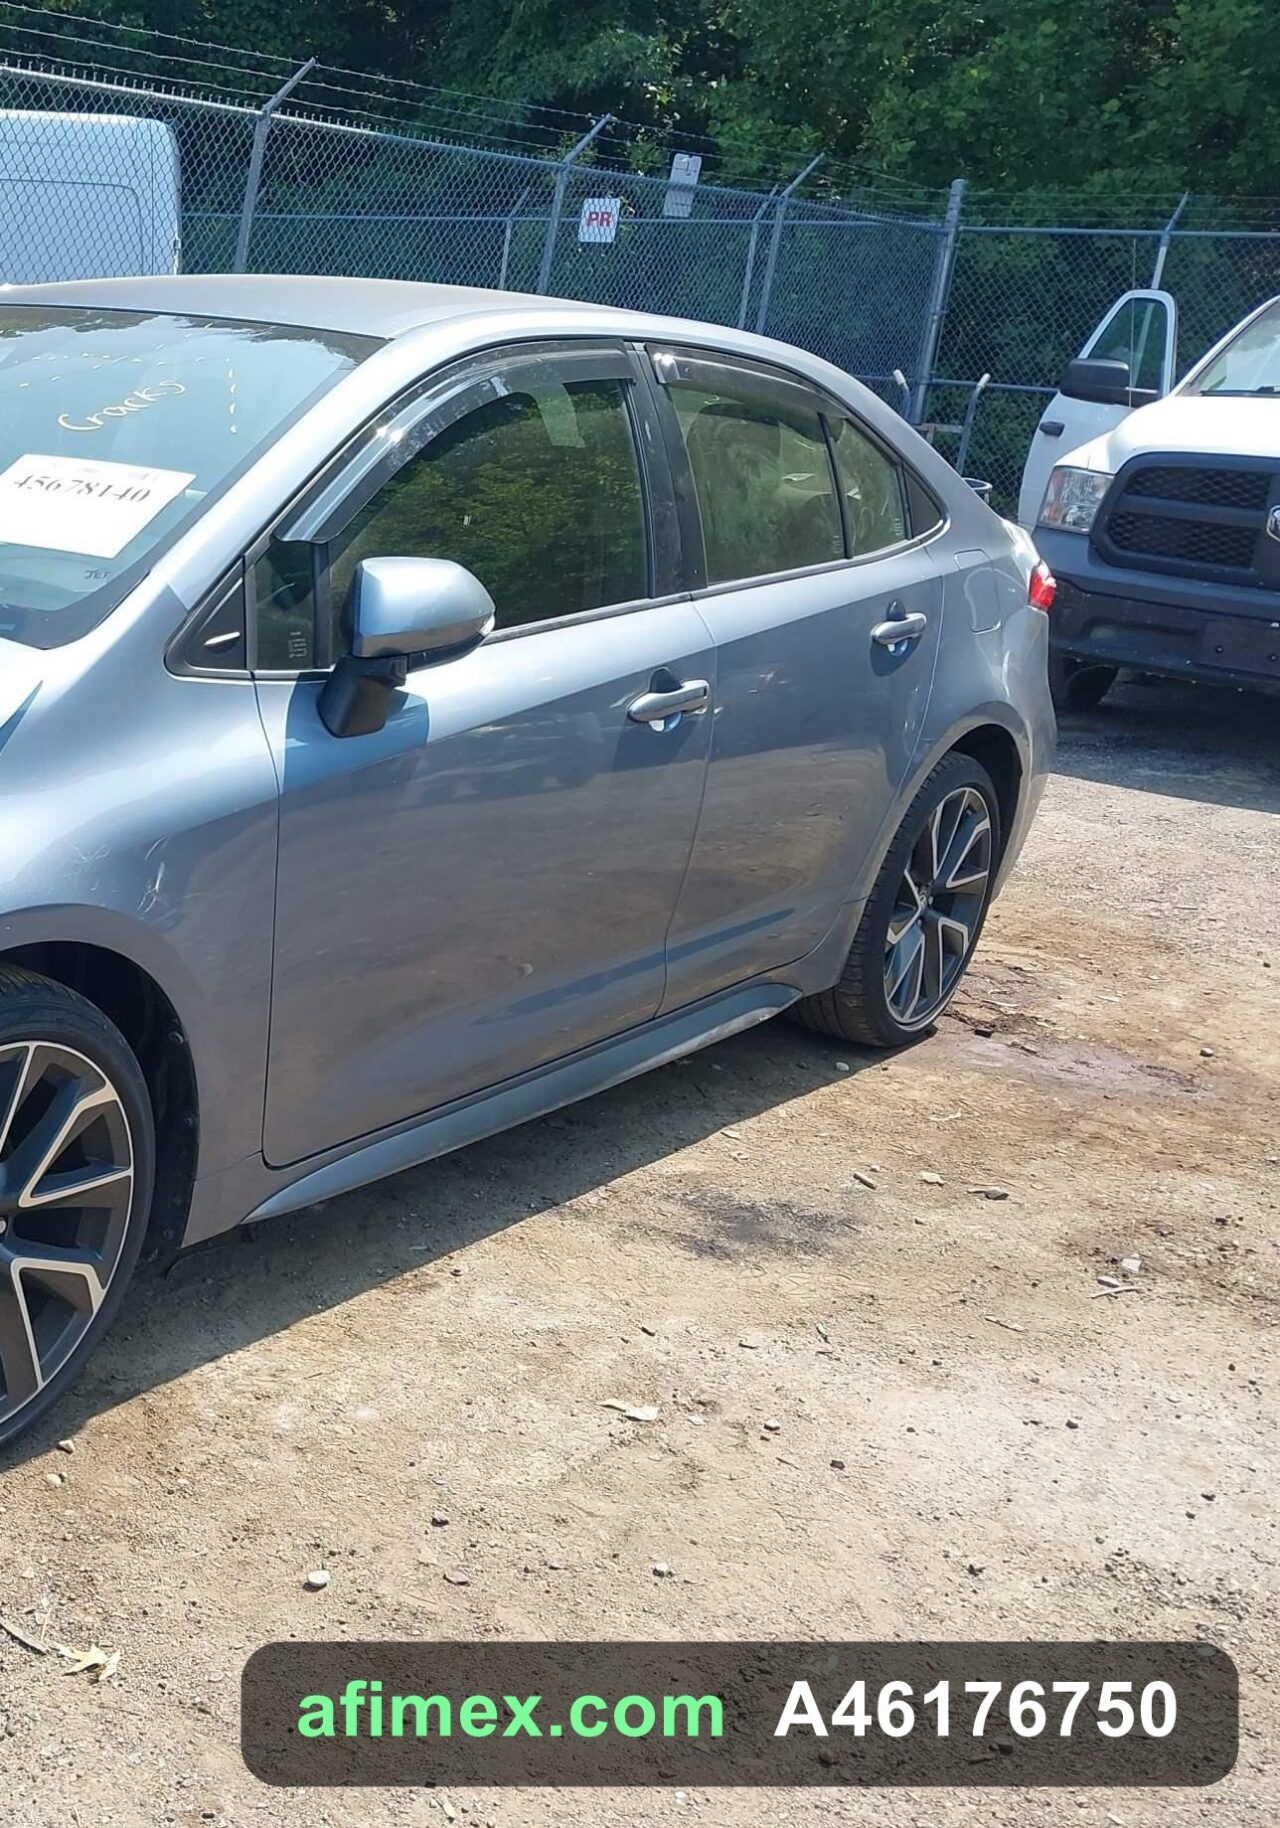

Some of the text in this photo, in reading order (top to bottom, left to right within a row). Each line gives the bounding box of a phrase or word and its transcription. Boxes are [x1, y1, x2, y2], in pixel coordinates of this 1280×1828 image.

[587, 211, 612, 226] PR
[57, 379, 186, 431] Cracks
[13, 474, 151, 502] 45678140
